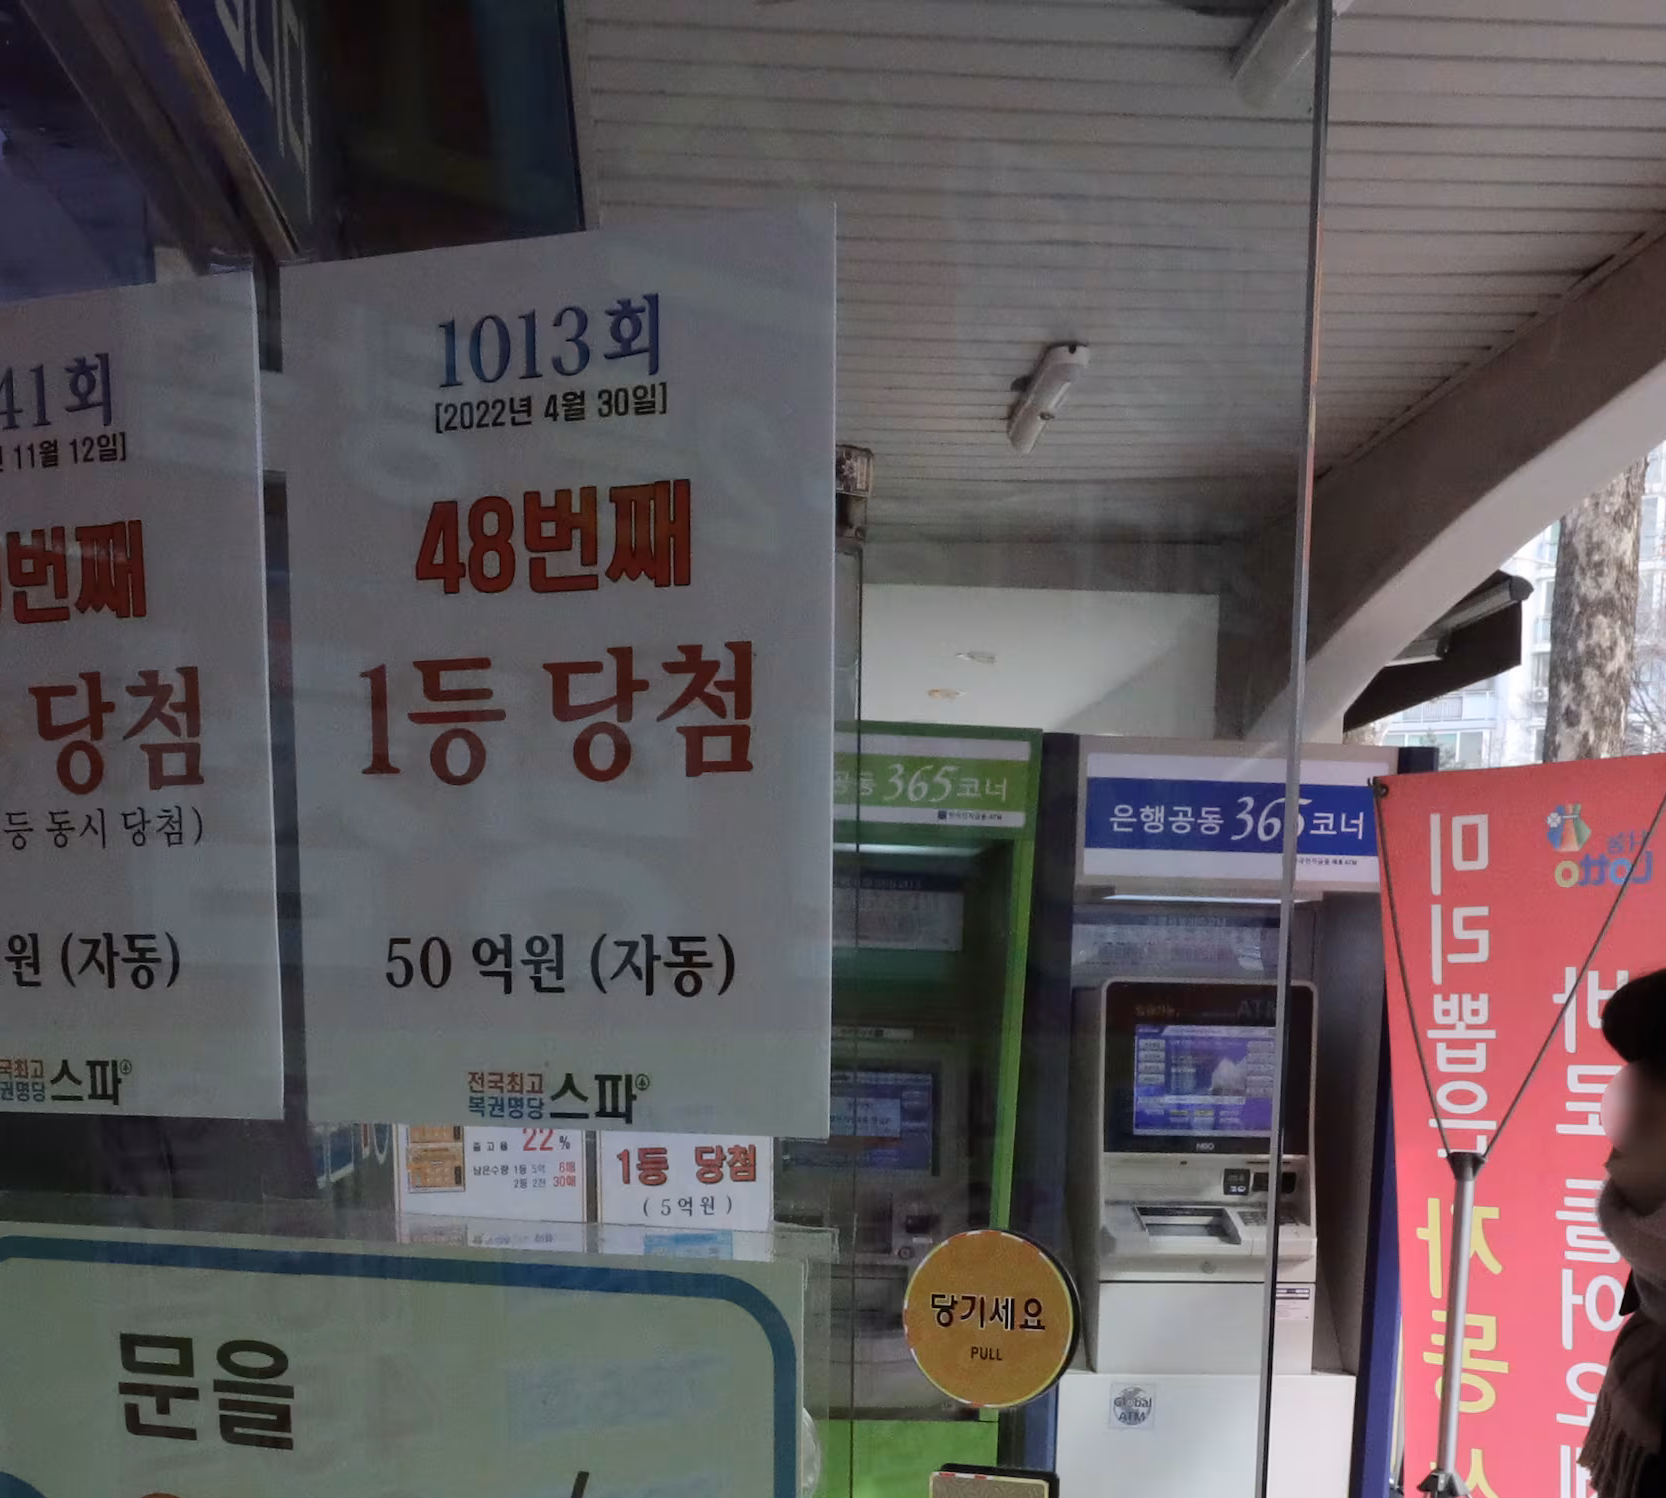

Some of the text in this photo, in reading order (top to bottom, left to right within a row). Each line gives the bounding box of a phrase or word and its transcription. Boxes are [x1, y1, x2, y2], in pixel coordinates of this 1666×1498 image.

[438, 293, 660, 388] 1013회
[434, 381, 668, 434] [2022년 4월 30일]
[14, 439, 59, 470] 11월
[70, 432, 127, 463] 12일]
[416, 479, 691, 595] 48번째
[28, 666, 205, 795] 당첨
[359, 640, 754, 786] 1등 당첨
[882, 763, 960, 803] 365
[957, 777, 1007, 802] 코너
[46, 808, 107, 849] 동시
[121, 805, 204, 849] 당첨)
[1109, 804, 1225, 836] 은행공동
[1309, 811, 1365, 841] 코너
[61, 931, 181, 991] (자동)
[591, 933, 735, 998] (자동)
[50, 1059, 123, 1105] 스파
[467, 1071, 544, 1095] 전국최고
[549, 1072, 638, 1125] 스파
[468, 1096, 545, 1120] 복권명당
[617, 1144, 757, 1186] 1등 당첨
[929, 1291, 1047, 1333] 당기세요
[968, 1346, 1005, 1363] PULL
[118, 1330, 296, 1453] 문을
[1118, 1411, 1146, 1423] ATM
